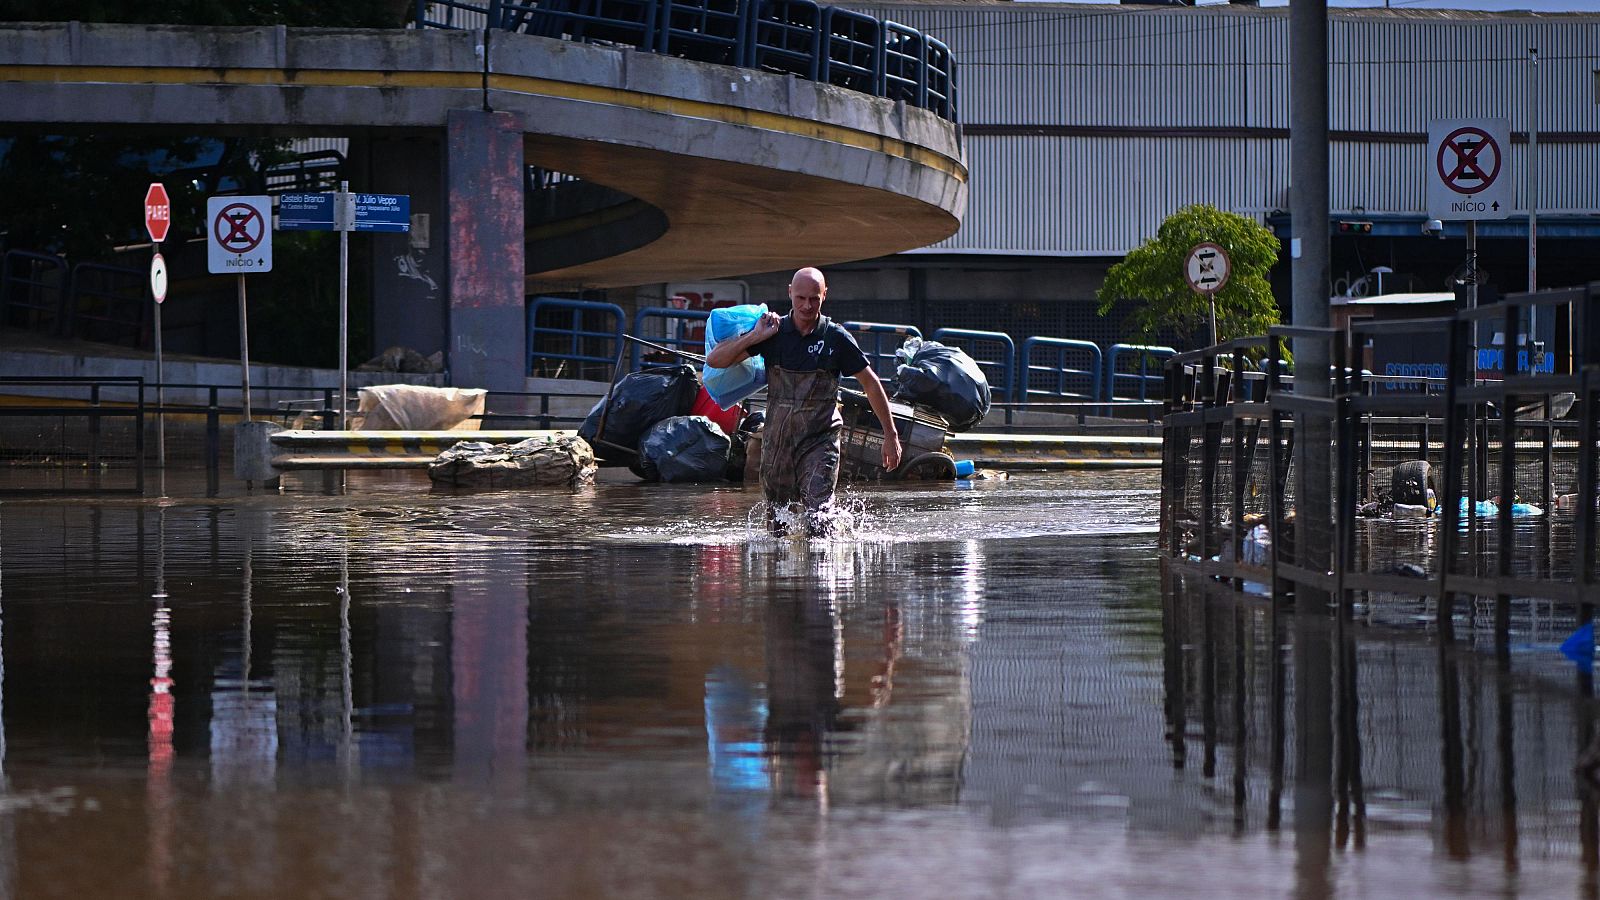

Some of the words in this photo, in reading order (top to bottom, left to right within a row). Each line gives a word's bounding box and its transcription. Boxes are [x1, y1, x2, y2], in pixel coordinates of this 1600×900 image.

[281, 194, 303, 203] Castelo
[303, 194, 325, 203] Branco
[377, 195, 397, 206] Veppo
[147, 204, 168, 220] PARE
[1451, 201, 1486, 212] INÍCIO
[226, 257, 253, 267] INÍCIO
